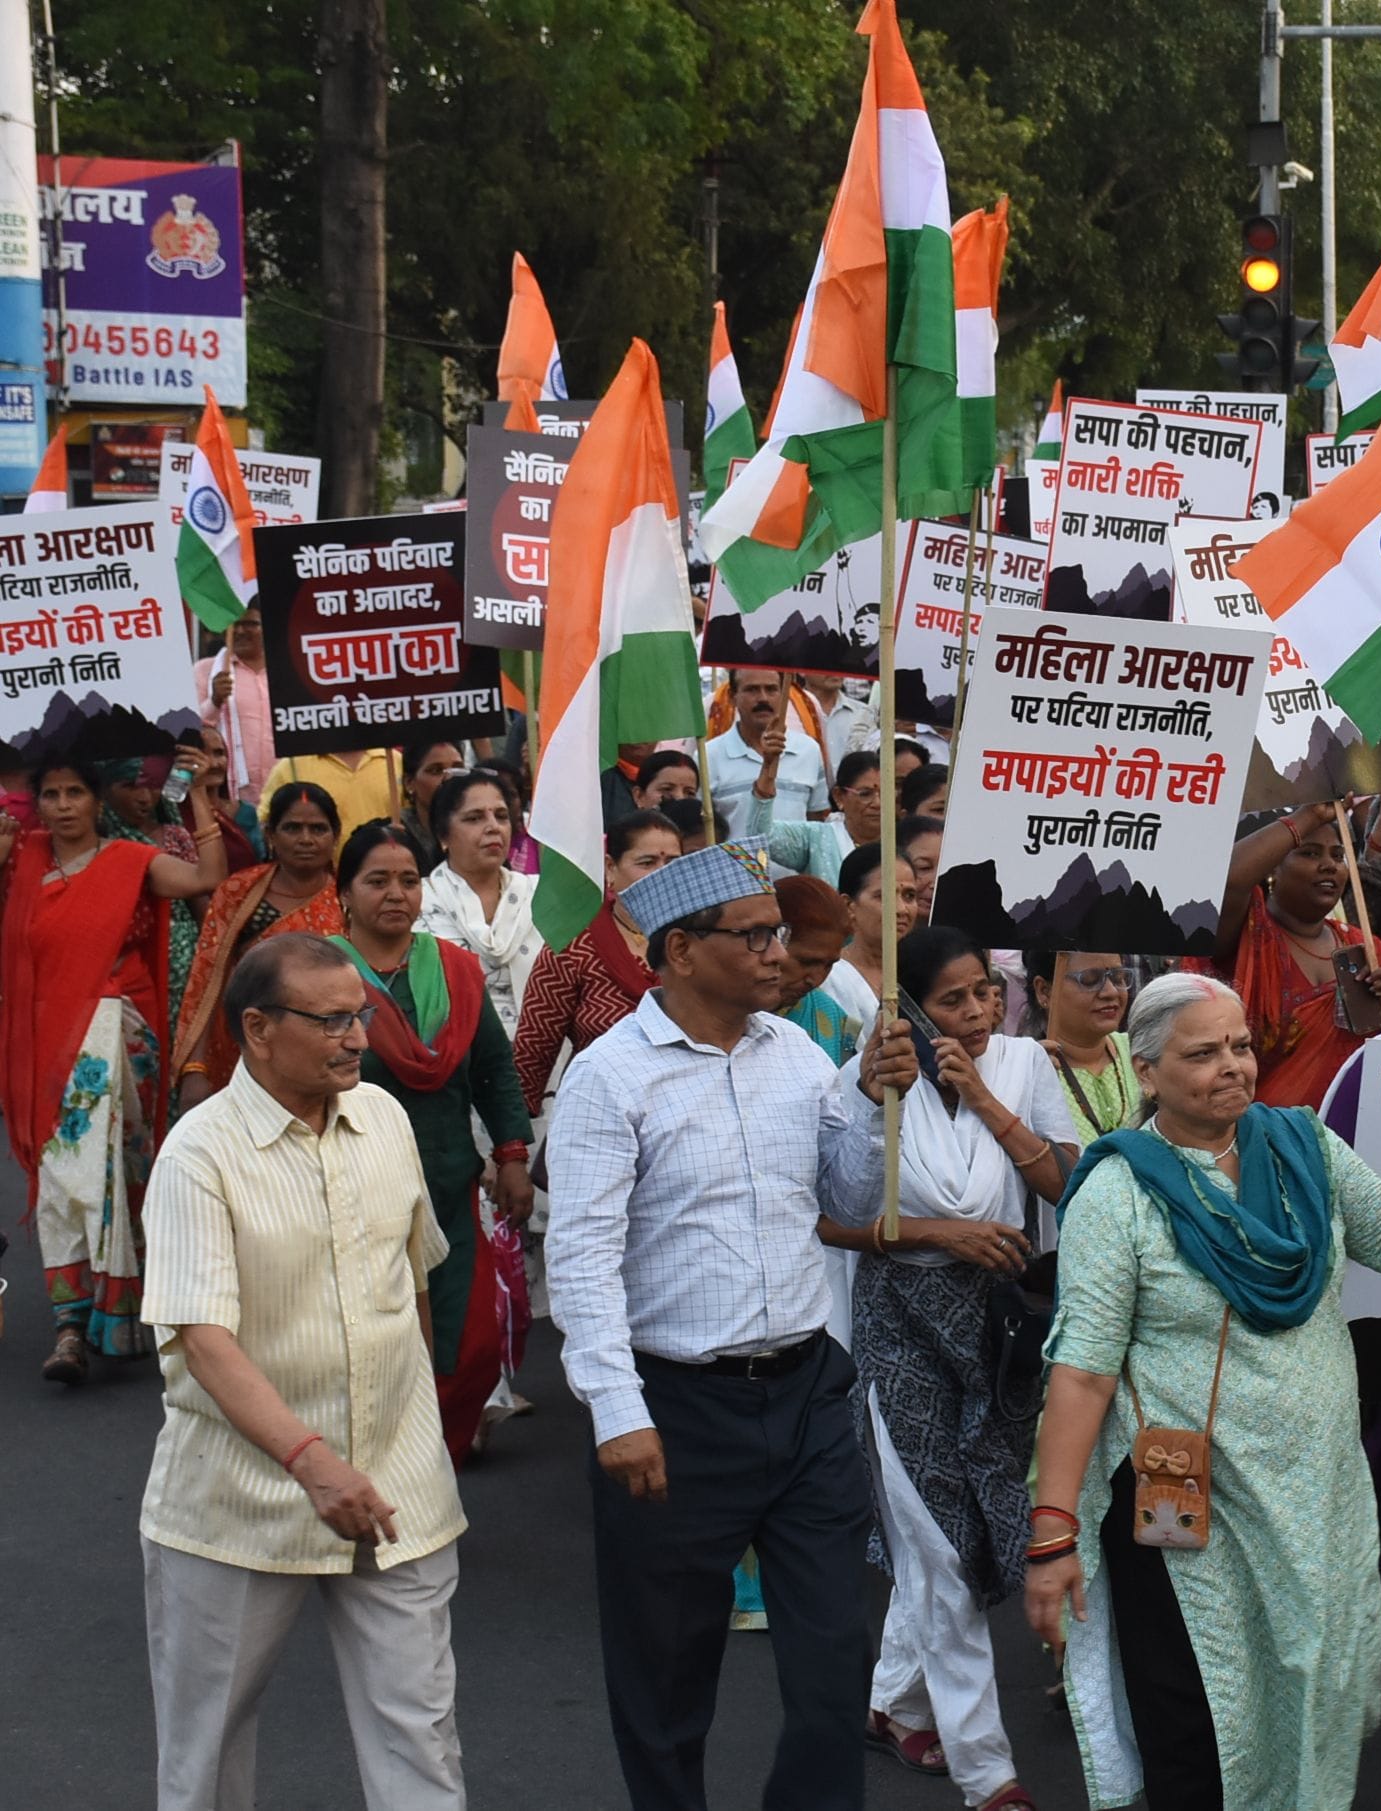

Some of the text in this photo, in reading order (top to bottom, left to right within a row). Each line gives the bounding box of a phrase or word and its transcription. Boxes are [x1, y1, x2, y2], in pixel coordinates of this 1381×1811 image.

[73, 364, 193, 388] Battle IAS
[1075, 413, 1253, 469] सपा की पहचान,
[1314, 444, 1357, 468] सपा
[1067, 456, 1121, 496] नारी
[1125, 461, 1184, 500] शक्ति
[35, 522, 155, 563] आरक्षण
[1062, 511, 1168, 545] का अपमान
[45, 563, 139, 595] राजनीति,
[293, 537, 454, 580] सैनिक परिवार
[313, 583, 441, 617] का अनादर,
[933, 573, 953, 592] पर
[62, 605, 104, 645] की
[109, 597, 163, 641] रही
[473, 596, 542, 627] असली
[1215, 594, 1241, 618] पर
[301, 621, 462, 685] सपा का
[995, 624, 1115, 684] महिला
[1117, 645, 1254, 696] आरक्षण
[0, 652, 121, 699] पुरानी निति
[274, 688, 501, 733] असली चेहरा उजागर।
[1011, 691, 1213, 742] पर घटिया राजनीति,
[1265, 679, 1321, 724] पुरानी
[982, 745, 1226, 805] सपाइयों की रही
[1023, 809, 1161, 855] पुरानी निति
